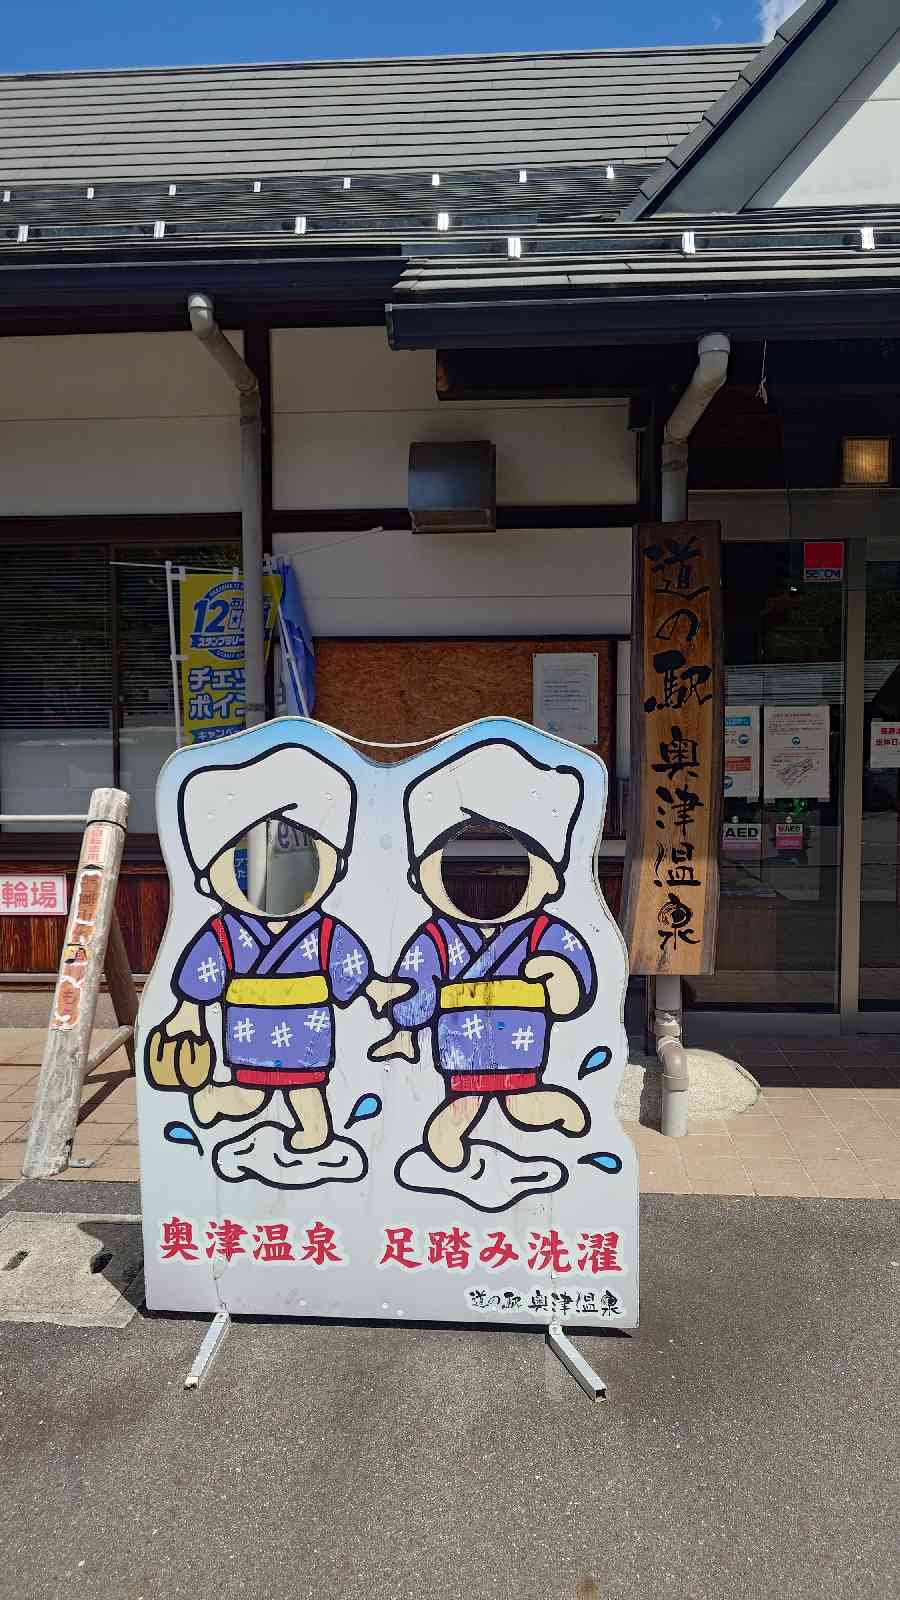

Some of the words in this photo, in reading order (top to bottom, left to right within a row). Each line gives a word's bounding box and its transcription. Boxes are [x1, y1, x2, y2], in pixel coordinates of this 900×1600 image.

[651, 725, 704, 950] 奥津温泉
[725, 828, 758, 838] AED
[1, 881, 57, 909] 輪場
[160, 1216, 343, 1263] 奥津温泉
[380, 1227, 623, 1274] 足踏み洗濯
[527, 1289, 622, 1316] 奥津温泉
